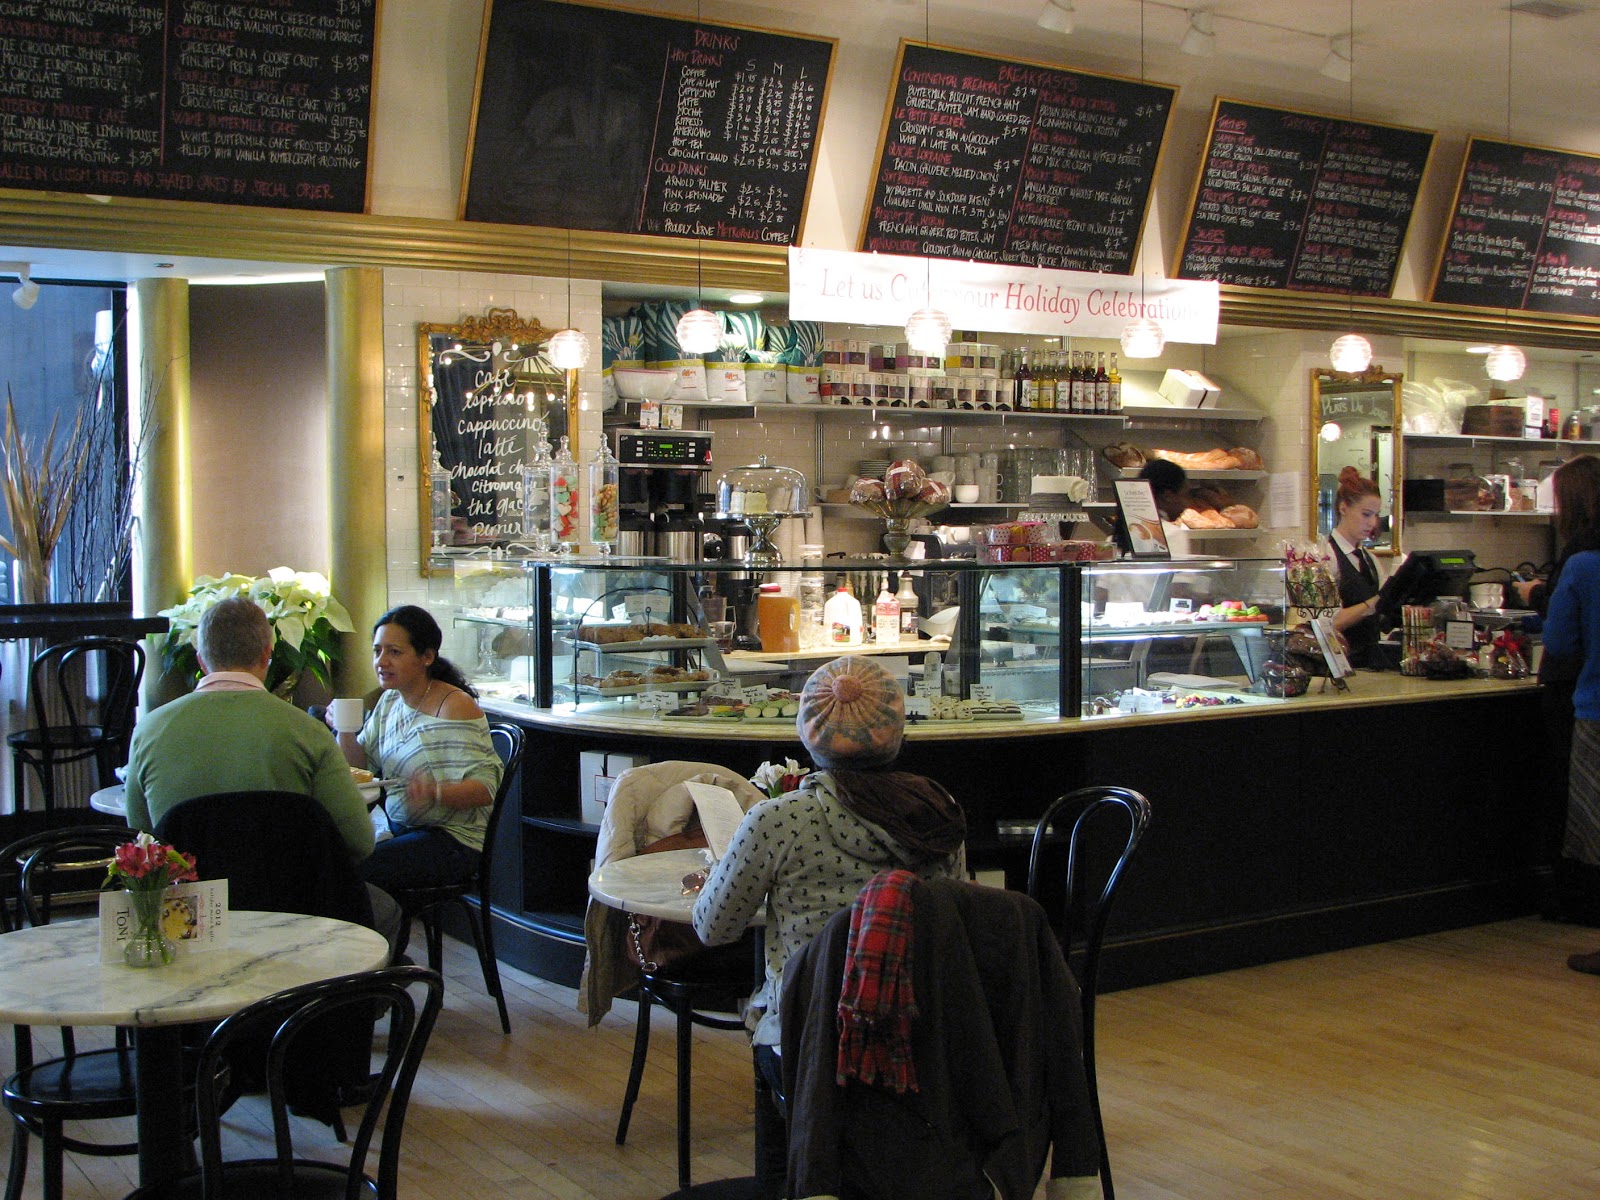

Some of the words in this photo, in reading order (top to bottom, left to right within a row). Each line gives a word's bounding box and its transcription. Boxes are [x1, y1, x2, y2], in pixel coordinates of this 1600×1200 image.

[821, 268, 853, 298] Let
[862, 281, 883, 300] us
[1005, 282, 1080, 324] Holiday
[116, 907, 129, 941] TONI
